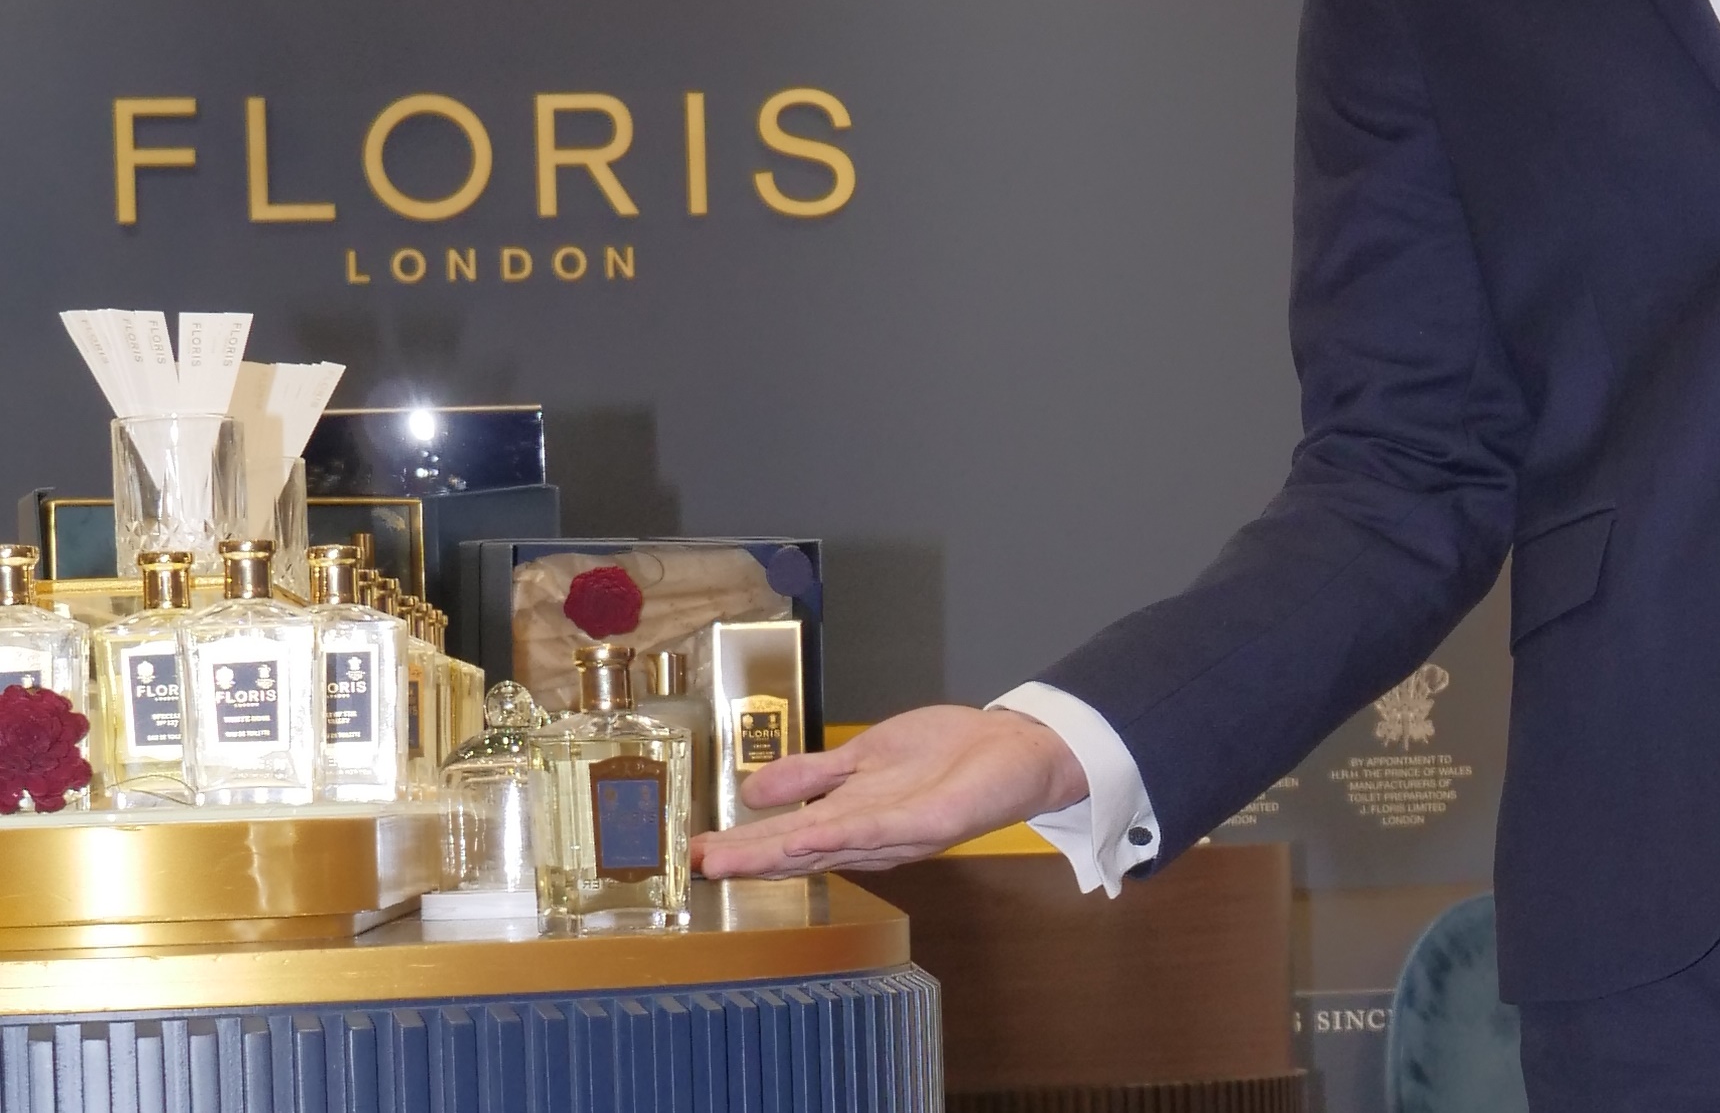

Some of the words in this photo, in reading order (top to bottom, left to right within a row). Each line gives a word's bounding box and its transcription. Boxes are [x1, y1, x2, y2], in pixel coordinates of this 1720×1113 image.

[111, 87, 857, 225] FLORIS
[345, 245, 637, 285] LONDON
[122, 318, 144, 364] FLORIS
[148, 319, 167, 365] FLORIS
[191, 322, 202, 367] FLORIS
[222, 322, 242, 367] FLORIS
[136, 684, 179, 698] FLOR
[327, 681, 367, 694] ORIS
[215, 689, 277, 704] FLORIS
[742, 729, 781, 738] FLORIS
[1350, 757, 1363, 767] BY
[1366, 755, 1437, 767] APPOINTMENT
[1438, 754, 1452, 764] TO
[1363, 768, 1381, 778] THE
[1384, 768, 1420, 778] PRINCE
[1423, 767, 1436, 776] OF
[1439, 765, 1473, 776] WALES
[1349, 779, 1436, 791] MANUFACTURERS
[1438, 779, 1452, 788] OF
[1348, 793, 1381, 803] TOILET
[1384, 790, 1457, 802] PREPARATIONS
[1370, 803, 1406, 814] FLORIS
[1407, 802, 1447, 813] LIMITED
[1382, 815, 1425, 826] LONDON
